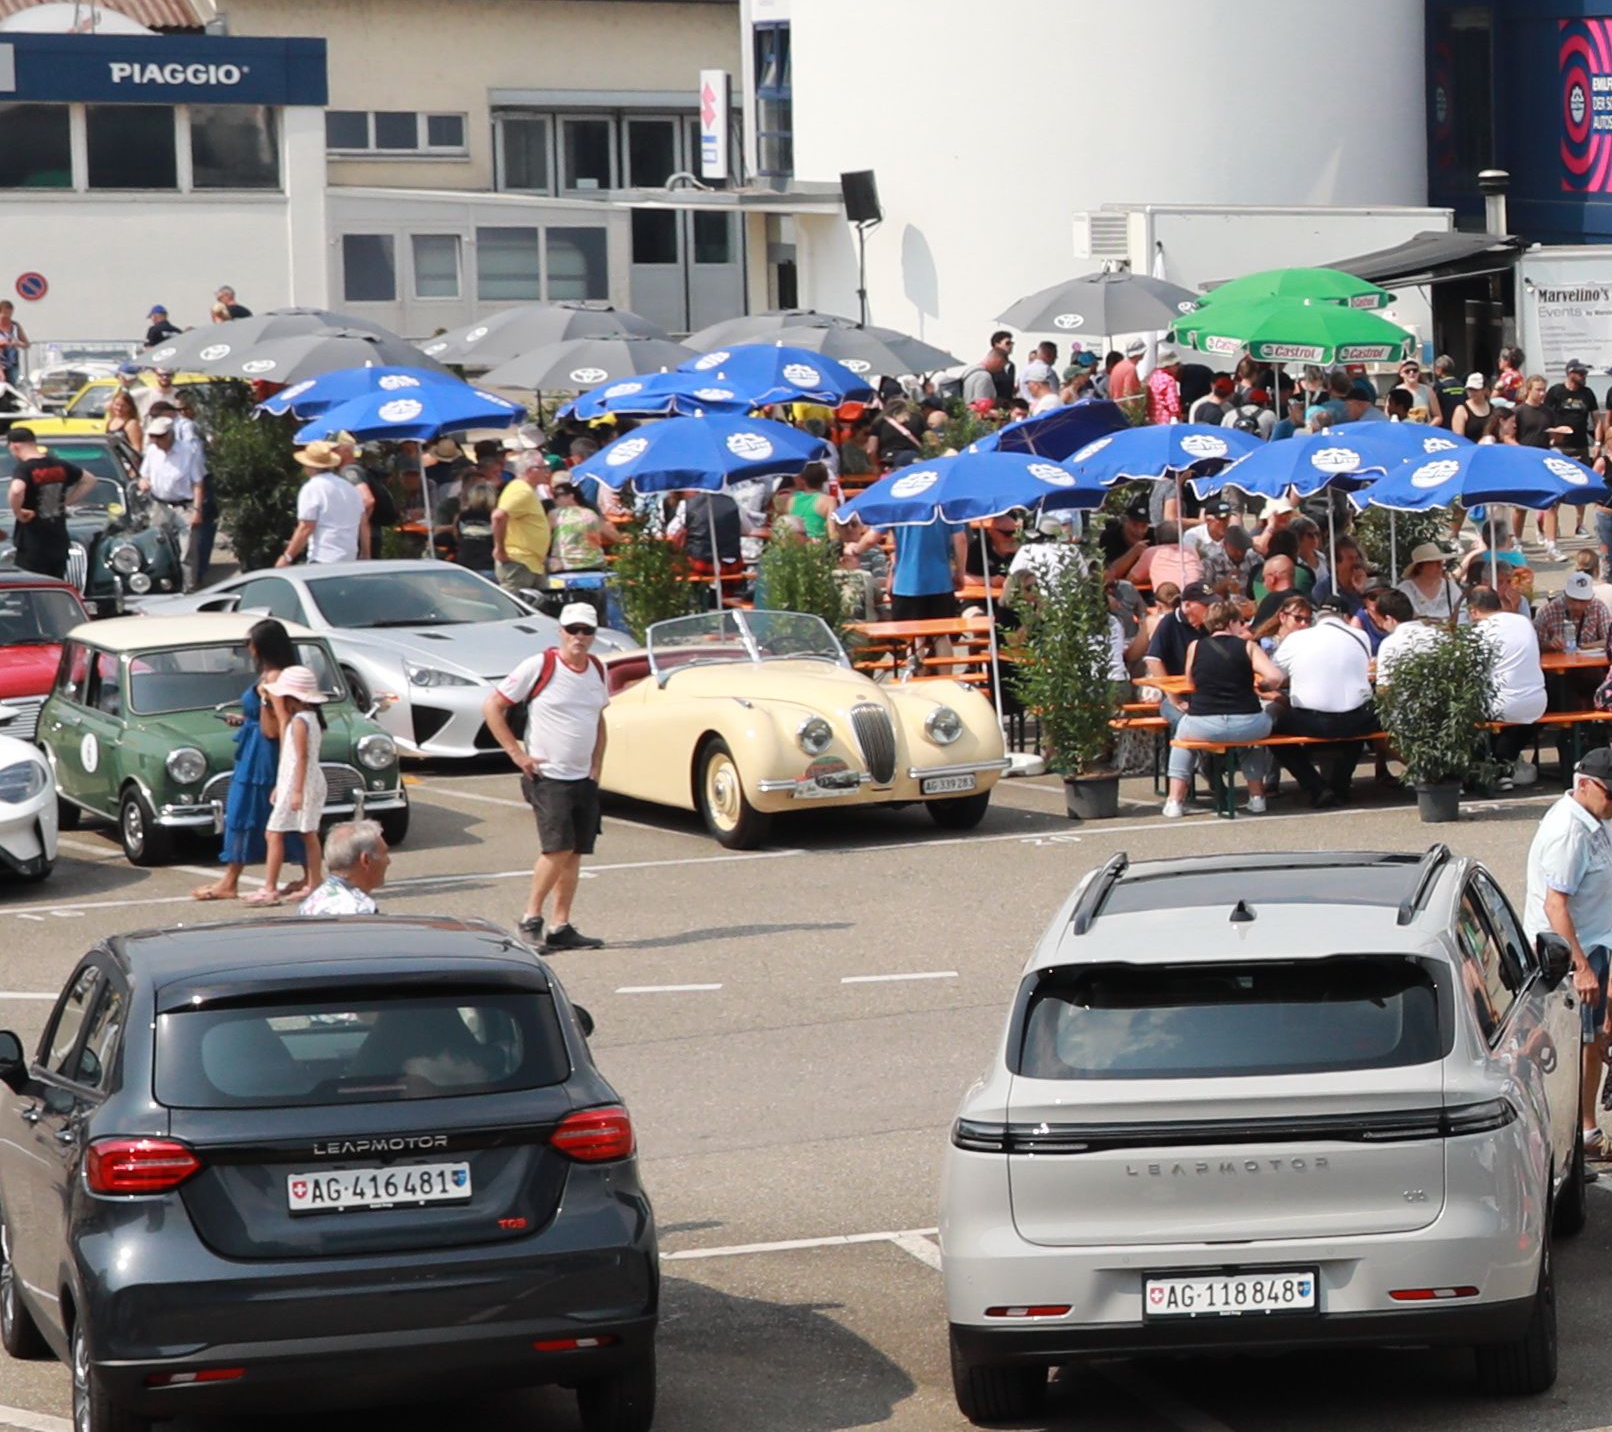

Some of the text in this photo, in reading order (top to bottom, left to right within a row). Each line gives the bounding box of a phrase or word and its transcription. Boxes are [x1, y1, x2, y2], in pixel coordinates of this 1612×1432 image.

[109, 63, 241, 85] PIAGGIO
[1538, 288, 1610, 303] Marvelino's
[1539, 307, 1582, 318] Events
[1275, 346, 1315, 358] Castrol
[1350, 347, 1385, 359] Castrol
[313, 1136, 448, 1156] LEAPMOTOR
[1126, 1157, 1330, 1177] LEAPMOTOR
[496, 1216, 529, 1229] T03
